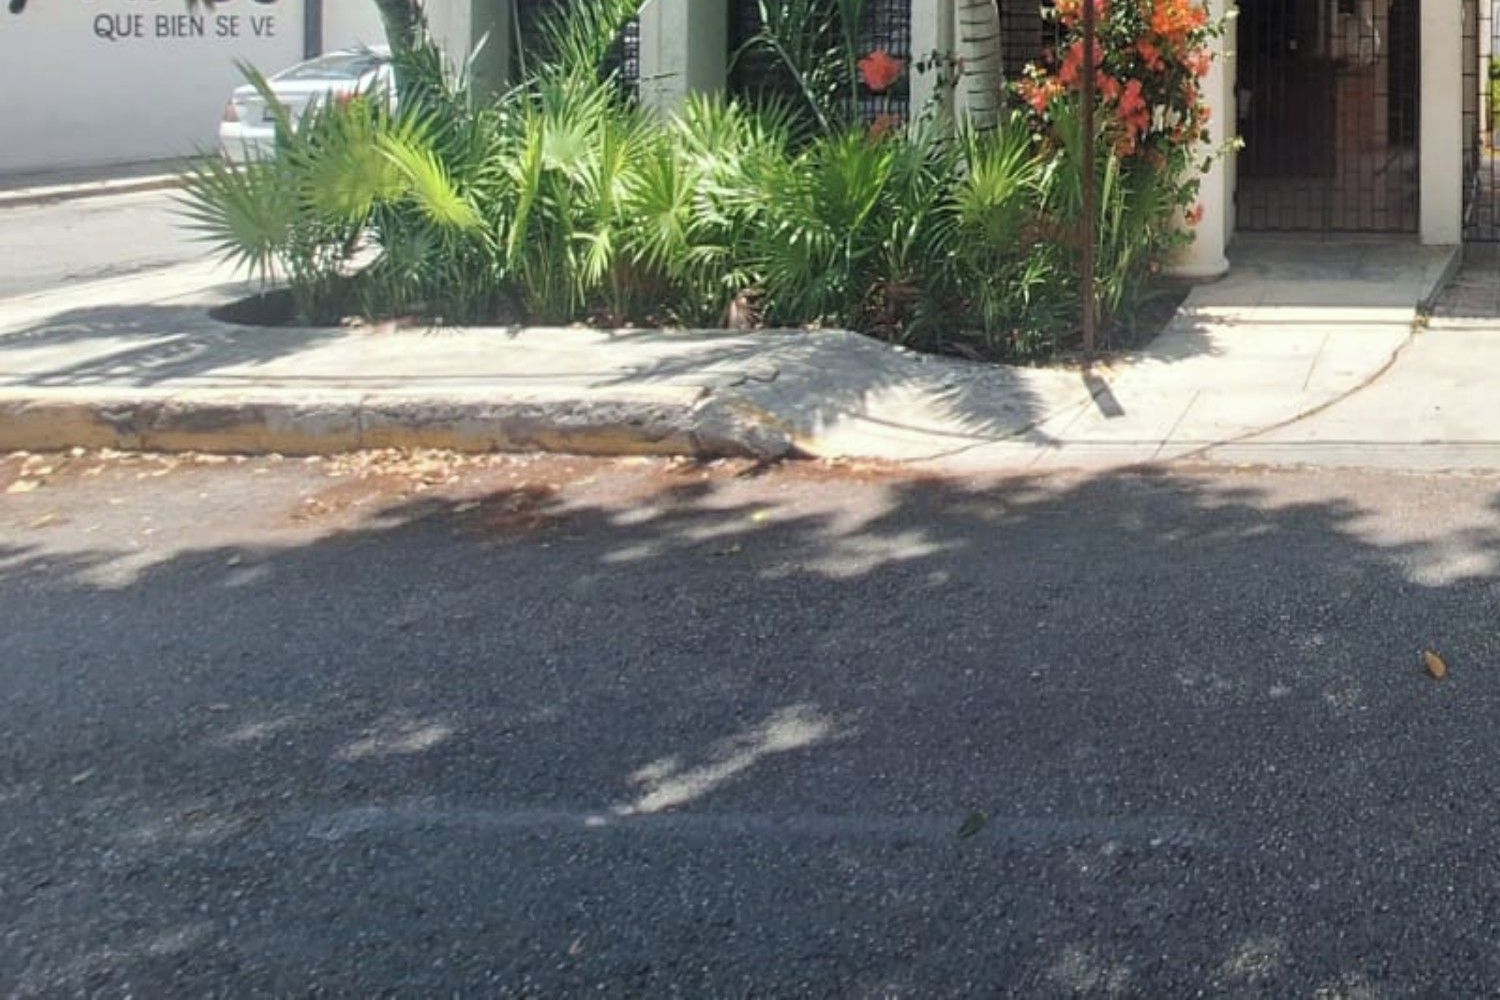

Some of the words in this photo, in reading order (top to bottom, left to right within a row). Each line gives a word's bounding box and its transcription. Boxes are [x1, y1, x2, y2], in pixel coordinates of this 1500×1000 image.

[93, 13, 144, 41] QUE
[155, 14, 204, 37] BIEN
[215, 15, 240, 36] SE
[250, 16, 276, 36] VE
